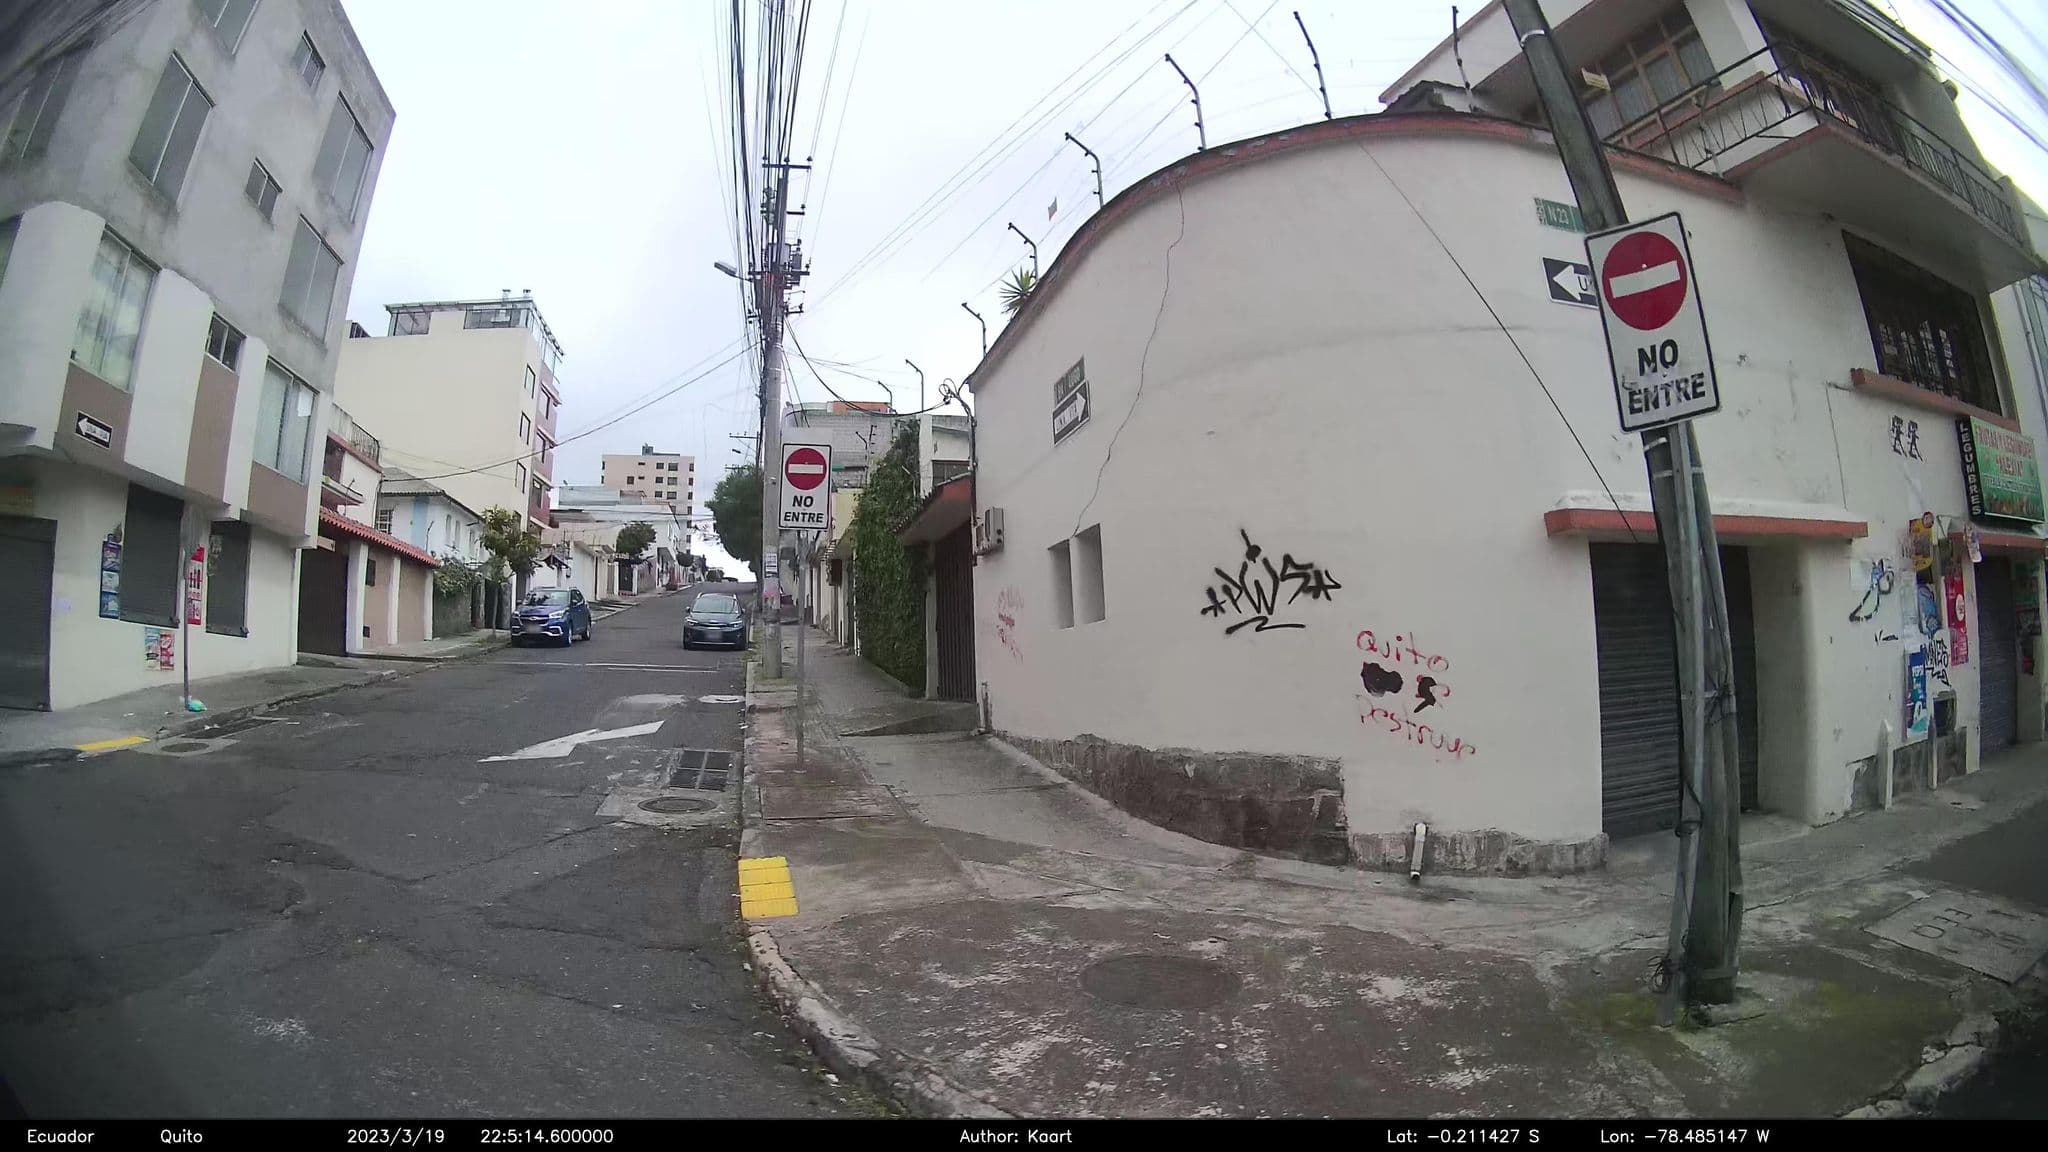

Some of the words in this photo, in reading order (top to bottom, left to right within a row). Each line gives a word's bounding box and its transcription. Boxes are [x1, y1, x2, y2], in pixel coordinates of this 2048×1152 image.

[1637, 338, 1680, 377] NO
[1628, 372, 1706, 415] ENTRE
[1959, 422, 1982, 516] LEGUMBRES
[783, 511, 825, 523] ENTRE
[792, 495, 814, 508] NO
[1356, 630, 1450, 673] Quito
